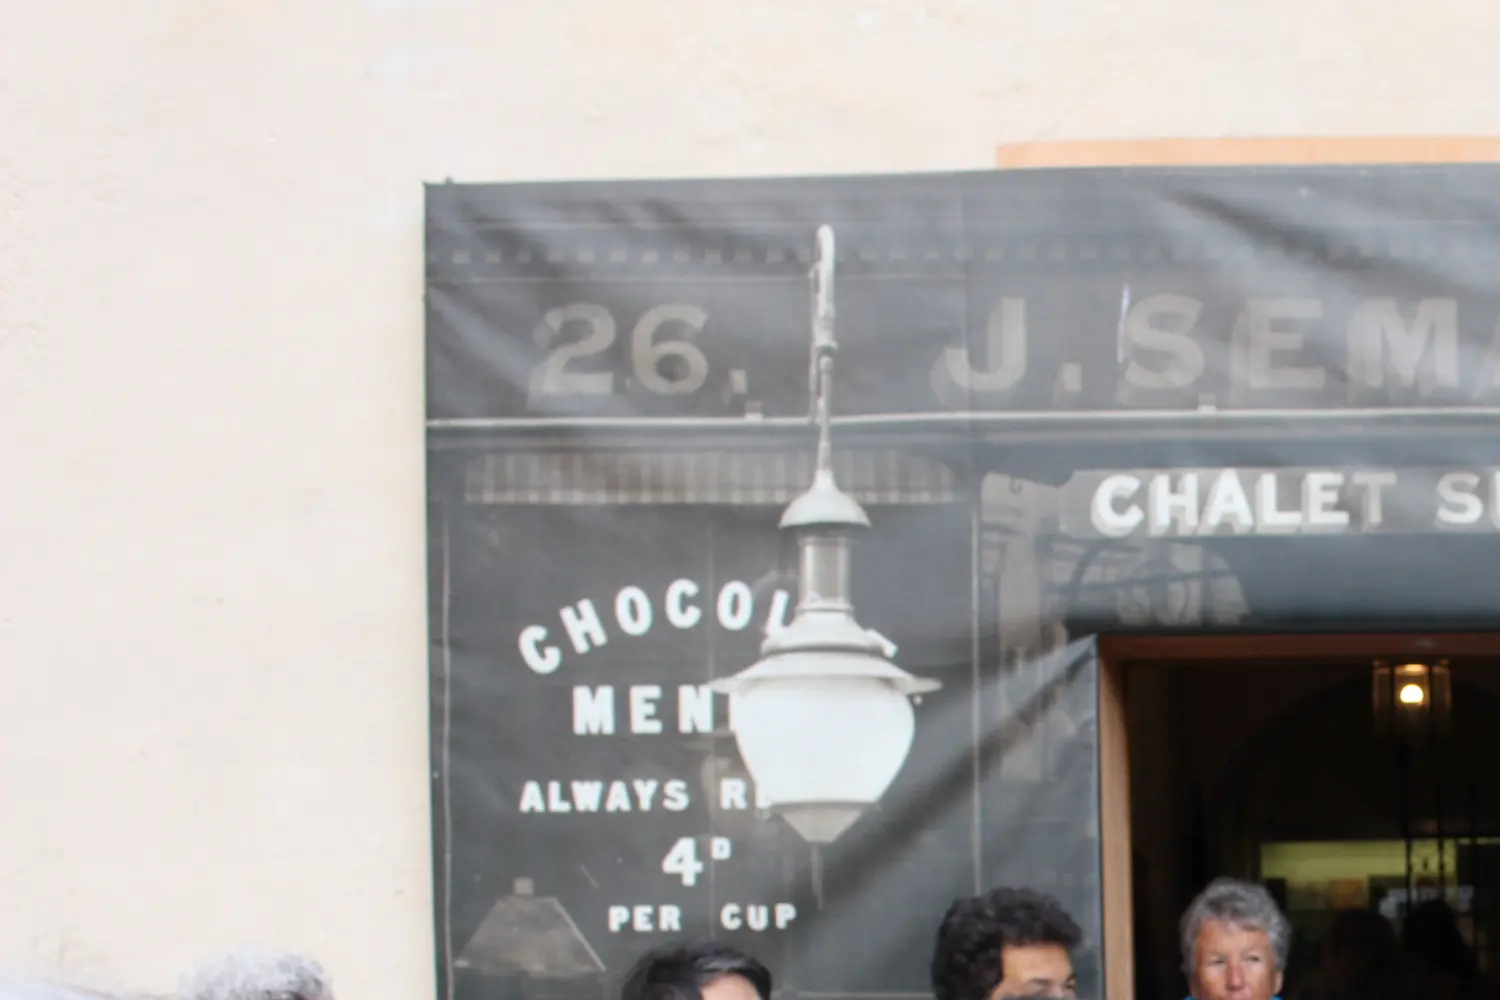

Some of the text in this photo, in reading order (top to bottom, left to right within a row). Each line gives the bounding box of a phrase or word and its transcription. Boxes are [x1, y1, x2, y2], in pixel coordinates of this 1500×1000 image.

[530, 302, 748, 397] 26.
[1090, 467, 1398, 537] CHALET
[572, 684, 736, 735] MEN
[519, 779, 691, 813] ALWAYS
[608, 902, 797, 933] PER CUP
